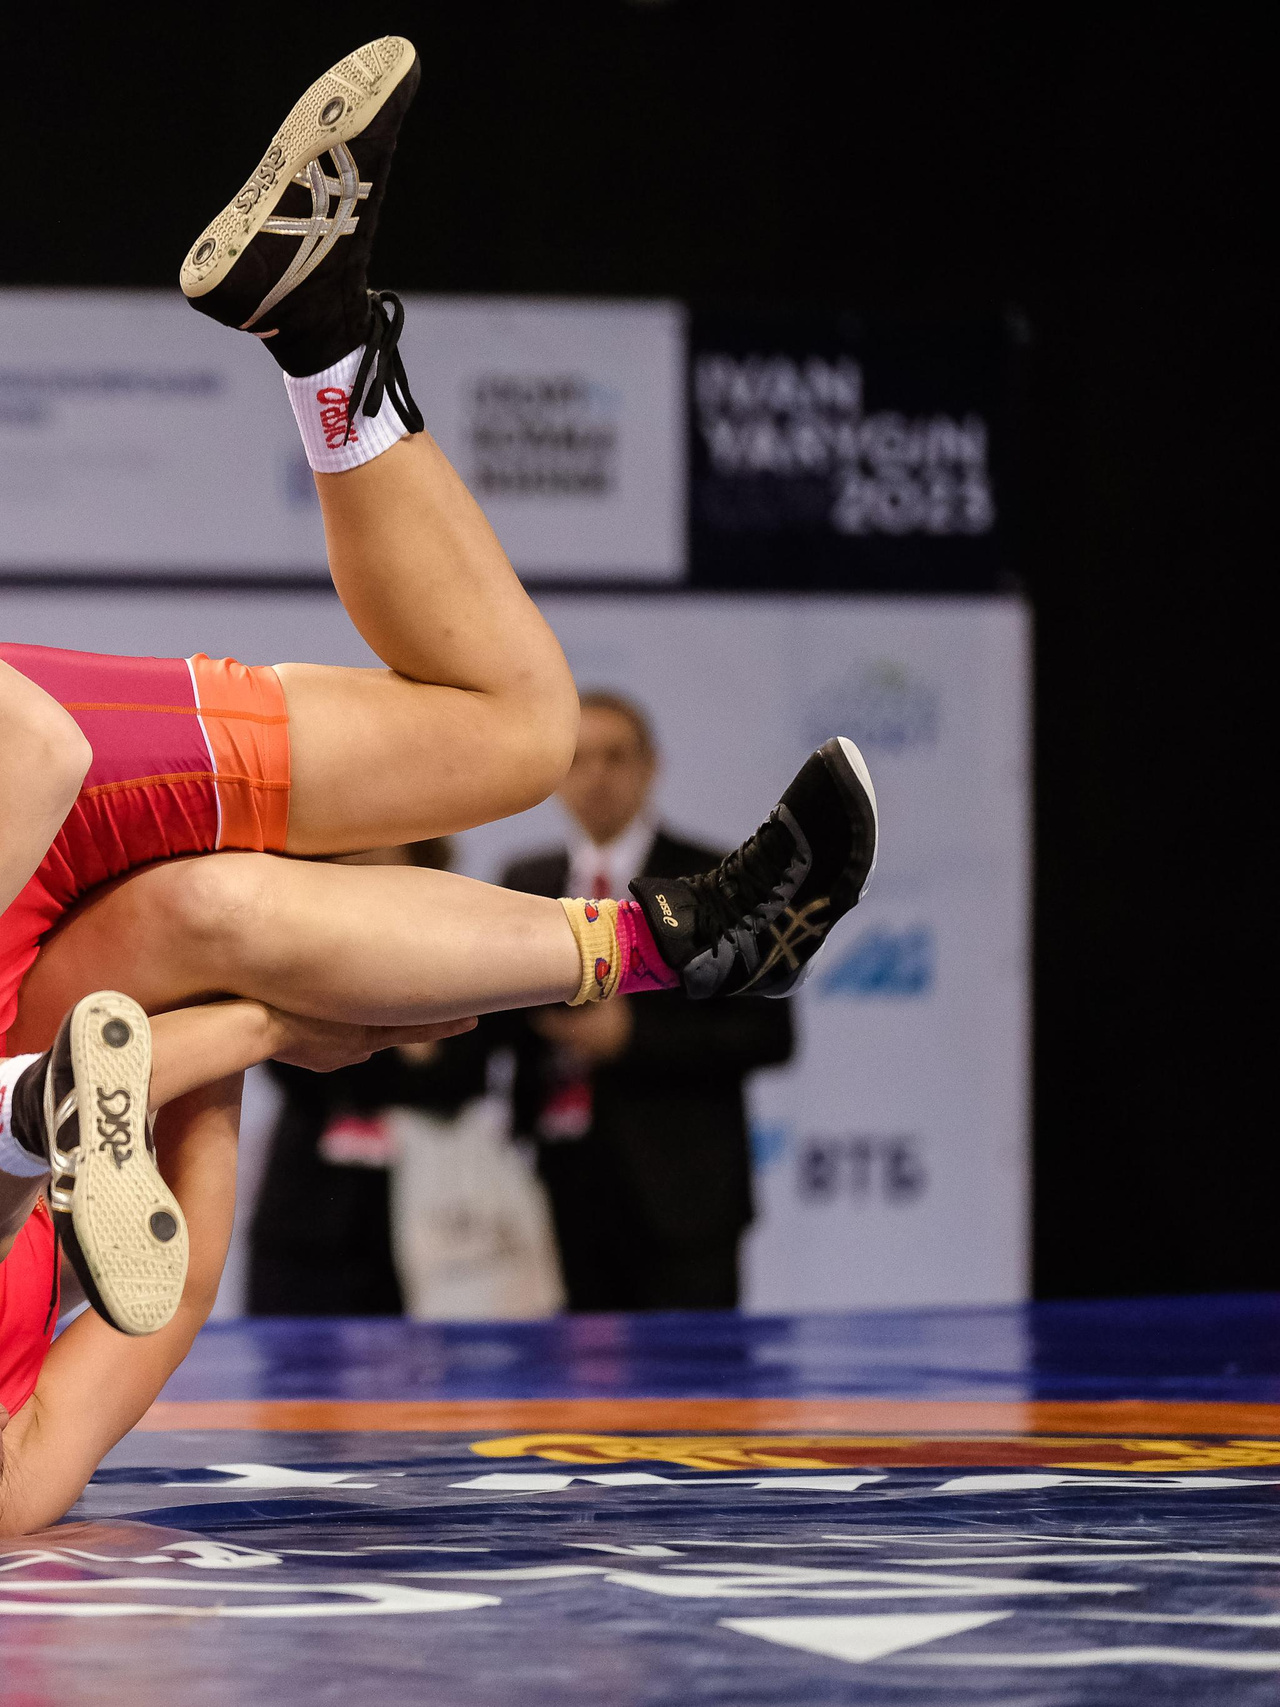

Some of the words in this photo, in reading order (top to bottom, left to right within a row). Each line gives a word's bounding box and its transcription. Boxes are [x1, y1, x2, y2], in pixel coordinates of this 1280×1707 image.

[696, 356, 862, 406] IVAN
[702, 410, 988, 470] YARYGIN
[834, 474, 995, 532] 2023
